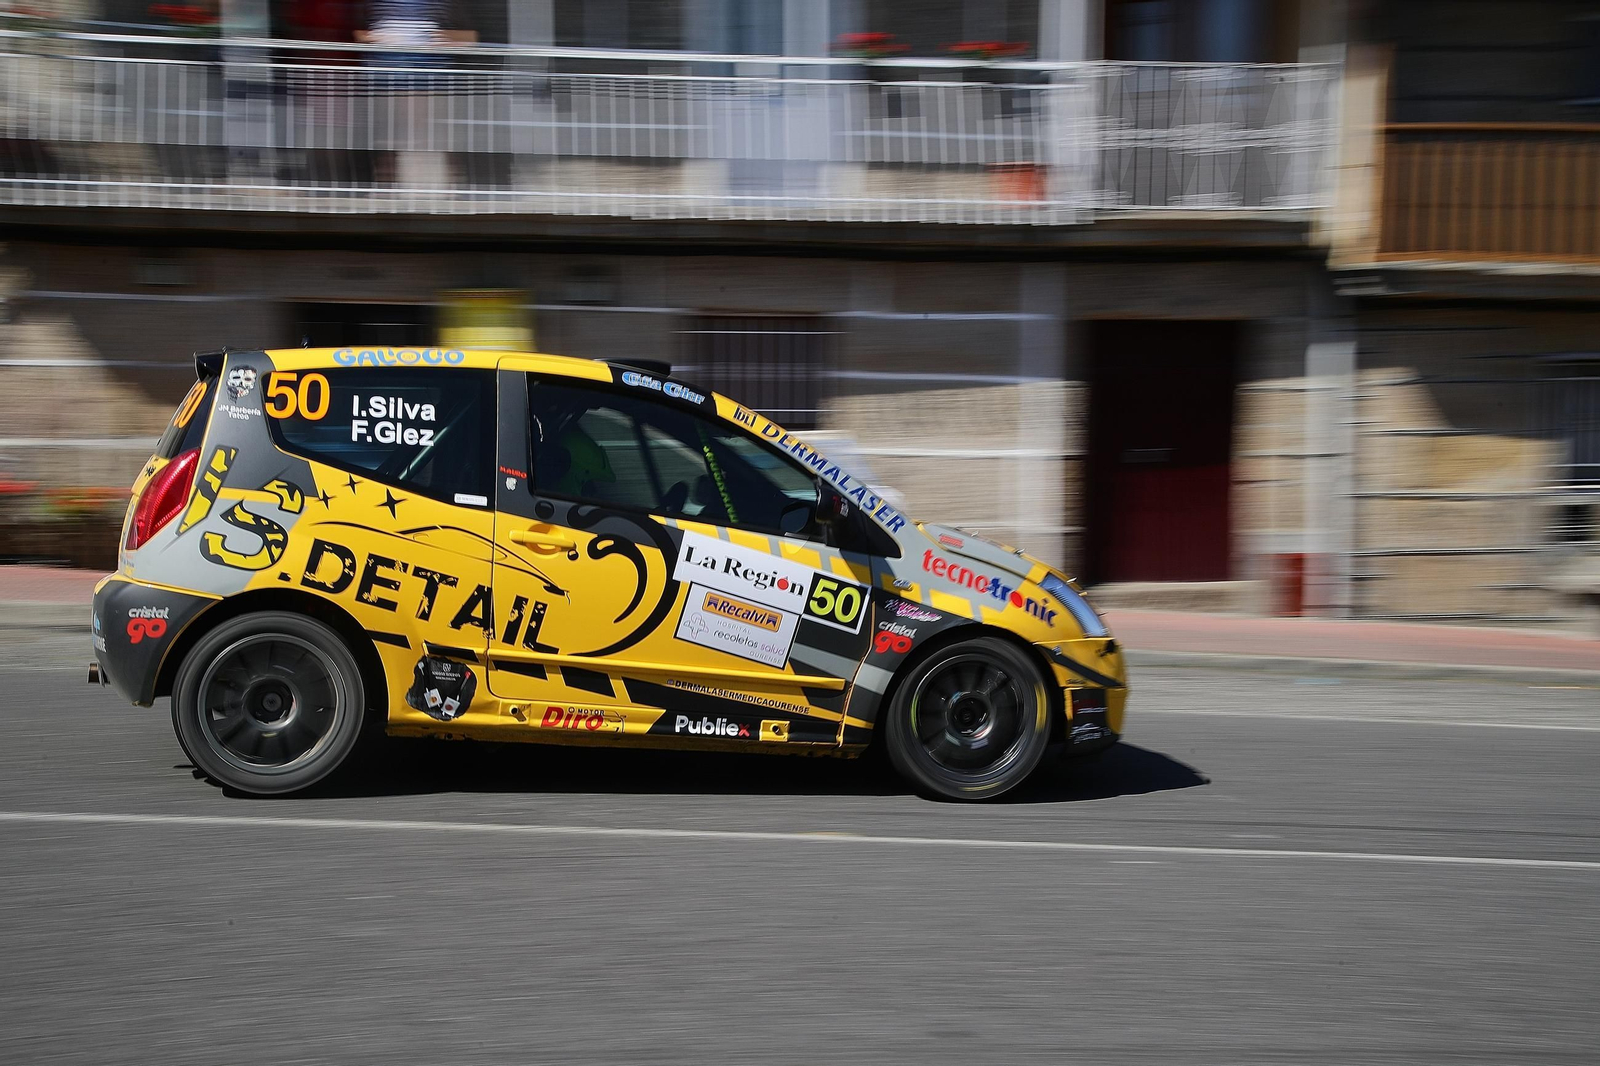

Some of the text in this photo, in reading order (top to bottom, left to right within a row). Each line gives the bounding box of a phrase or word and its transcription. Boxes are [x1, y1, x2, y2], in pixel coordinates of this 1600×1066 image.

[265, 371, 330, 421] 50
[352, 394, 436, 421] I.Silva
[351, 419, 434, 447] F.Glez
[499, 465, 528, 479] MAURO
[761, 422, 905, 534] DERMALASER
[682, 544, 716, 571] La
[128, 606, 169, 619] cristal
[809, 578, 861, 623] 50
[127, 617, 167, 644] go
[716, 619, 751, 634] HOSPITAL
[878, 620, 918, 639] cristal
[713, 629, 786, 657] recoletas salud
[874, 631, 912, 654] go
[749, 650, 782, 665] OURENSE
[540, 706, 604, 731] Diro
[675, 714, 750, 738] Publiex
